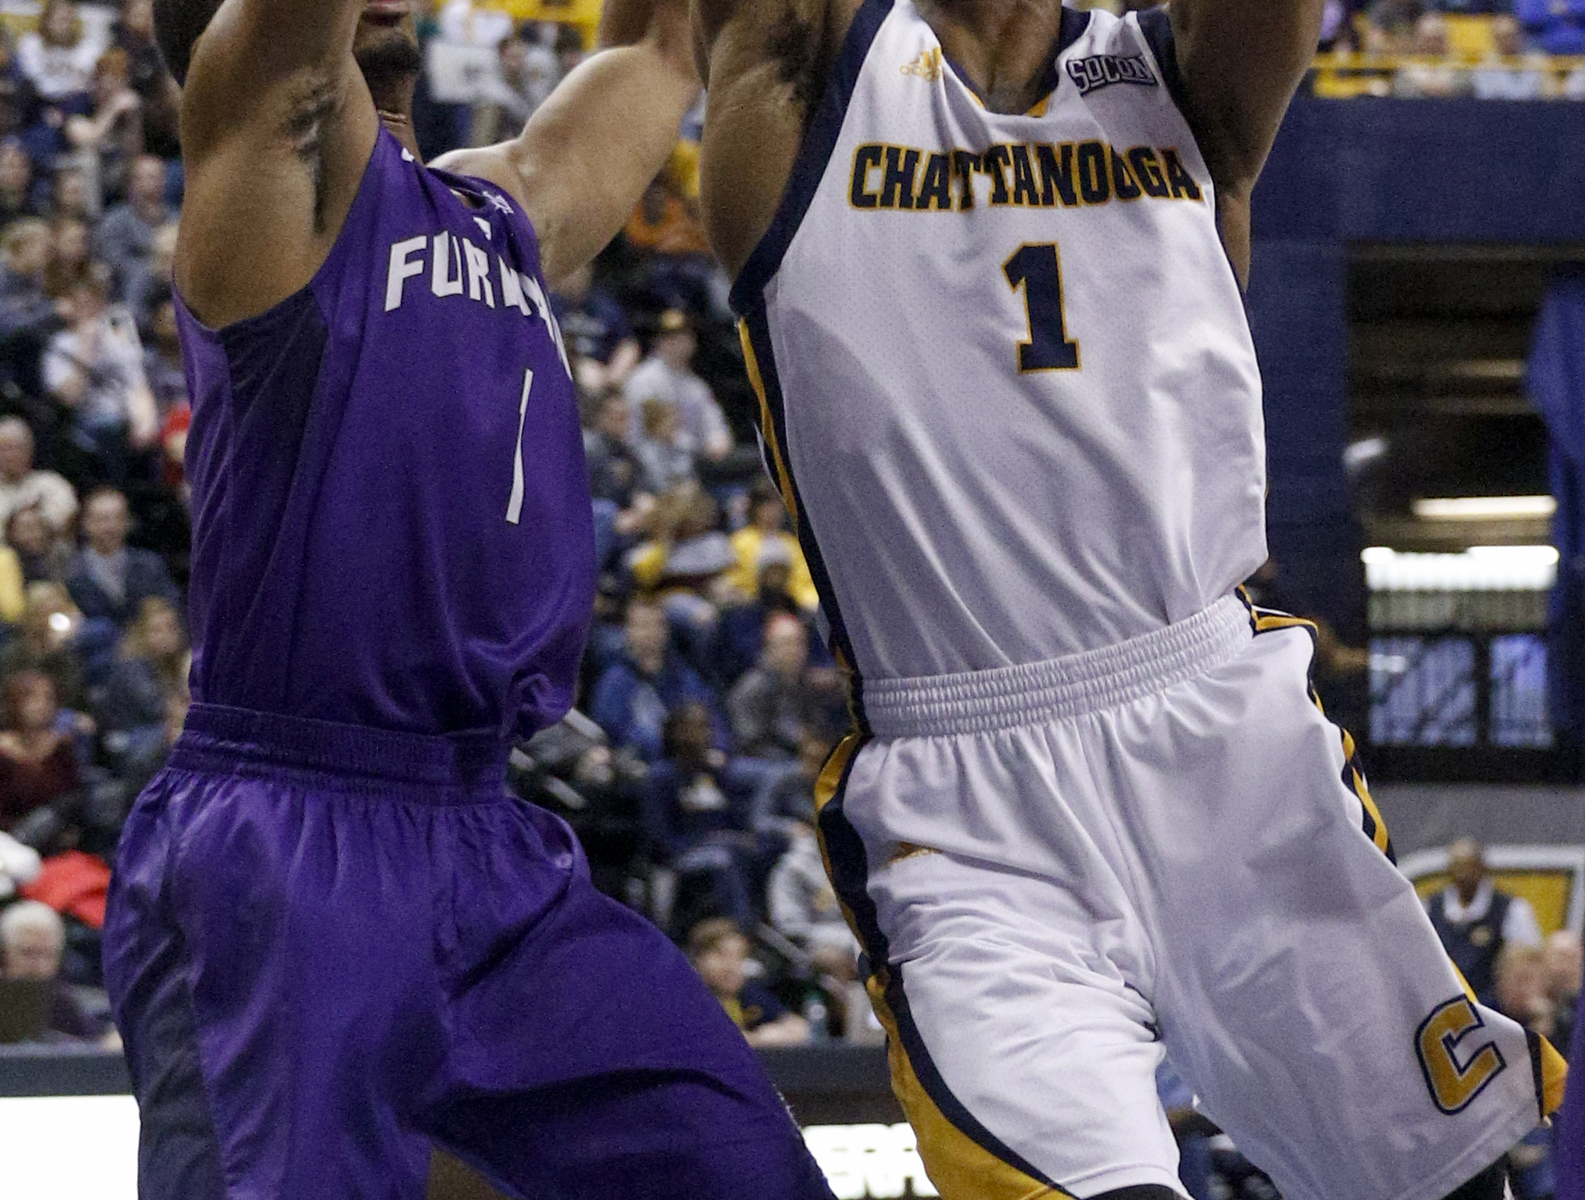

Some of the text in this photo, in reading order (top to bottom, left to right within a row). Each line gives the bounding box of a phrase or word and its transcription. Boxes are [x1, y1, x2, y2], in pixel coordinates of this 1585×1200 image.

[1066, 55, 1158, 96] SOCON
[848, 141, 1203, 212] CHATTANOOGA
[1002, 241, 1081, 373] 1
[1414, 993, 1507, 1116] C
